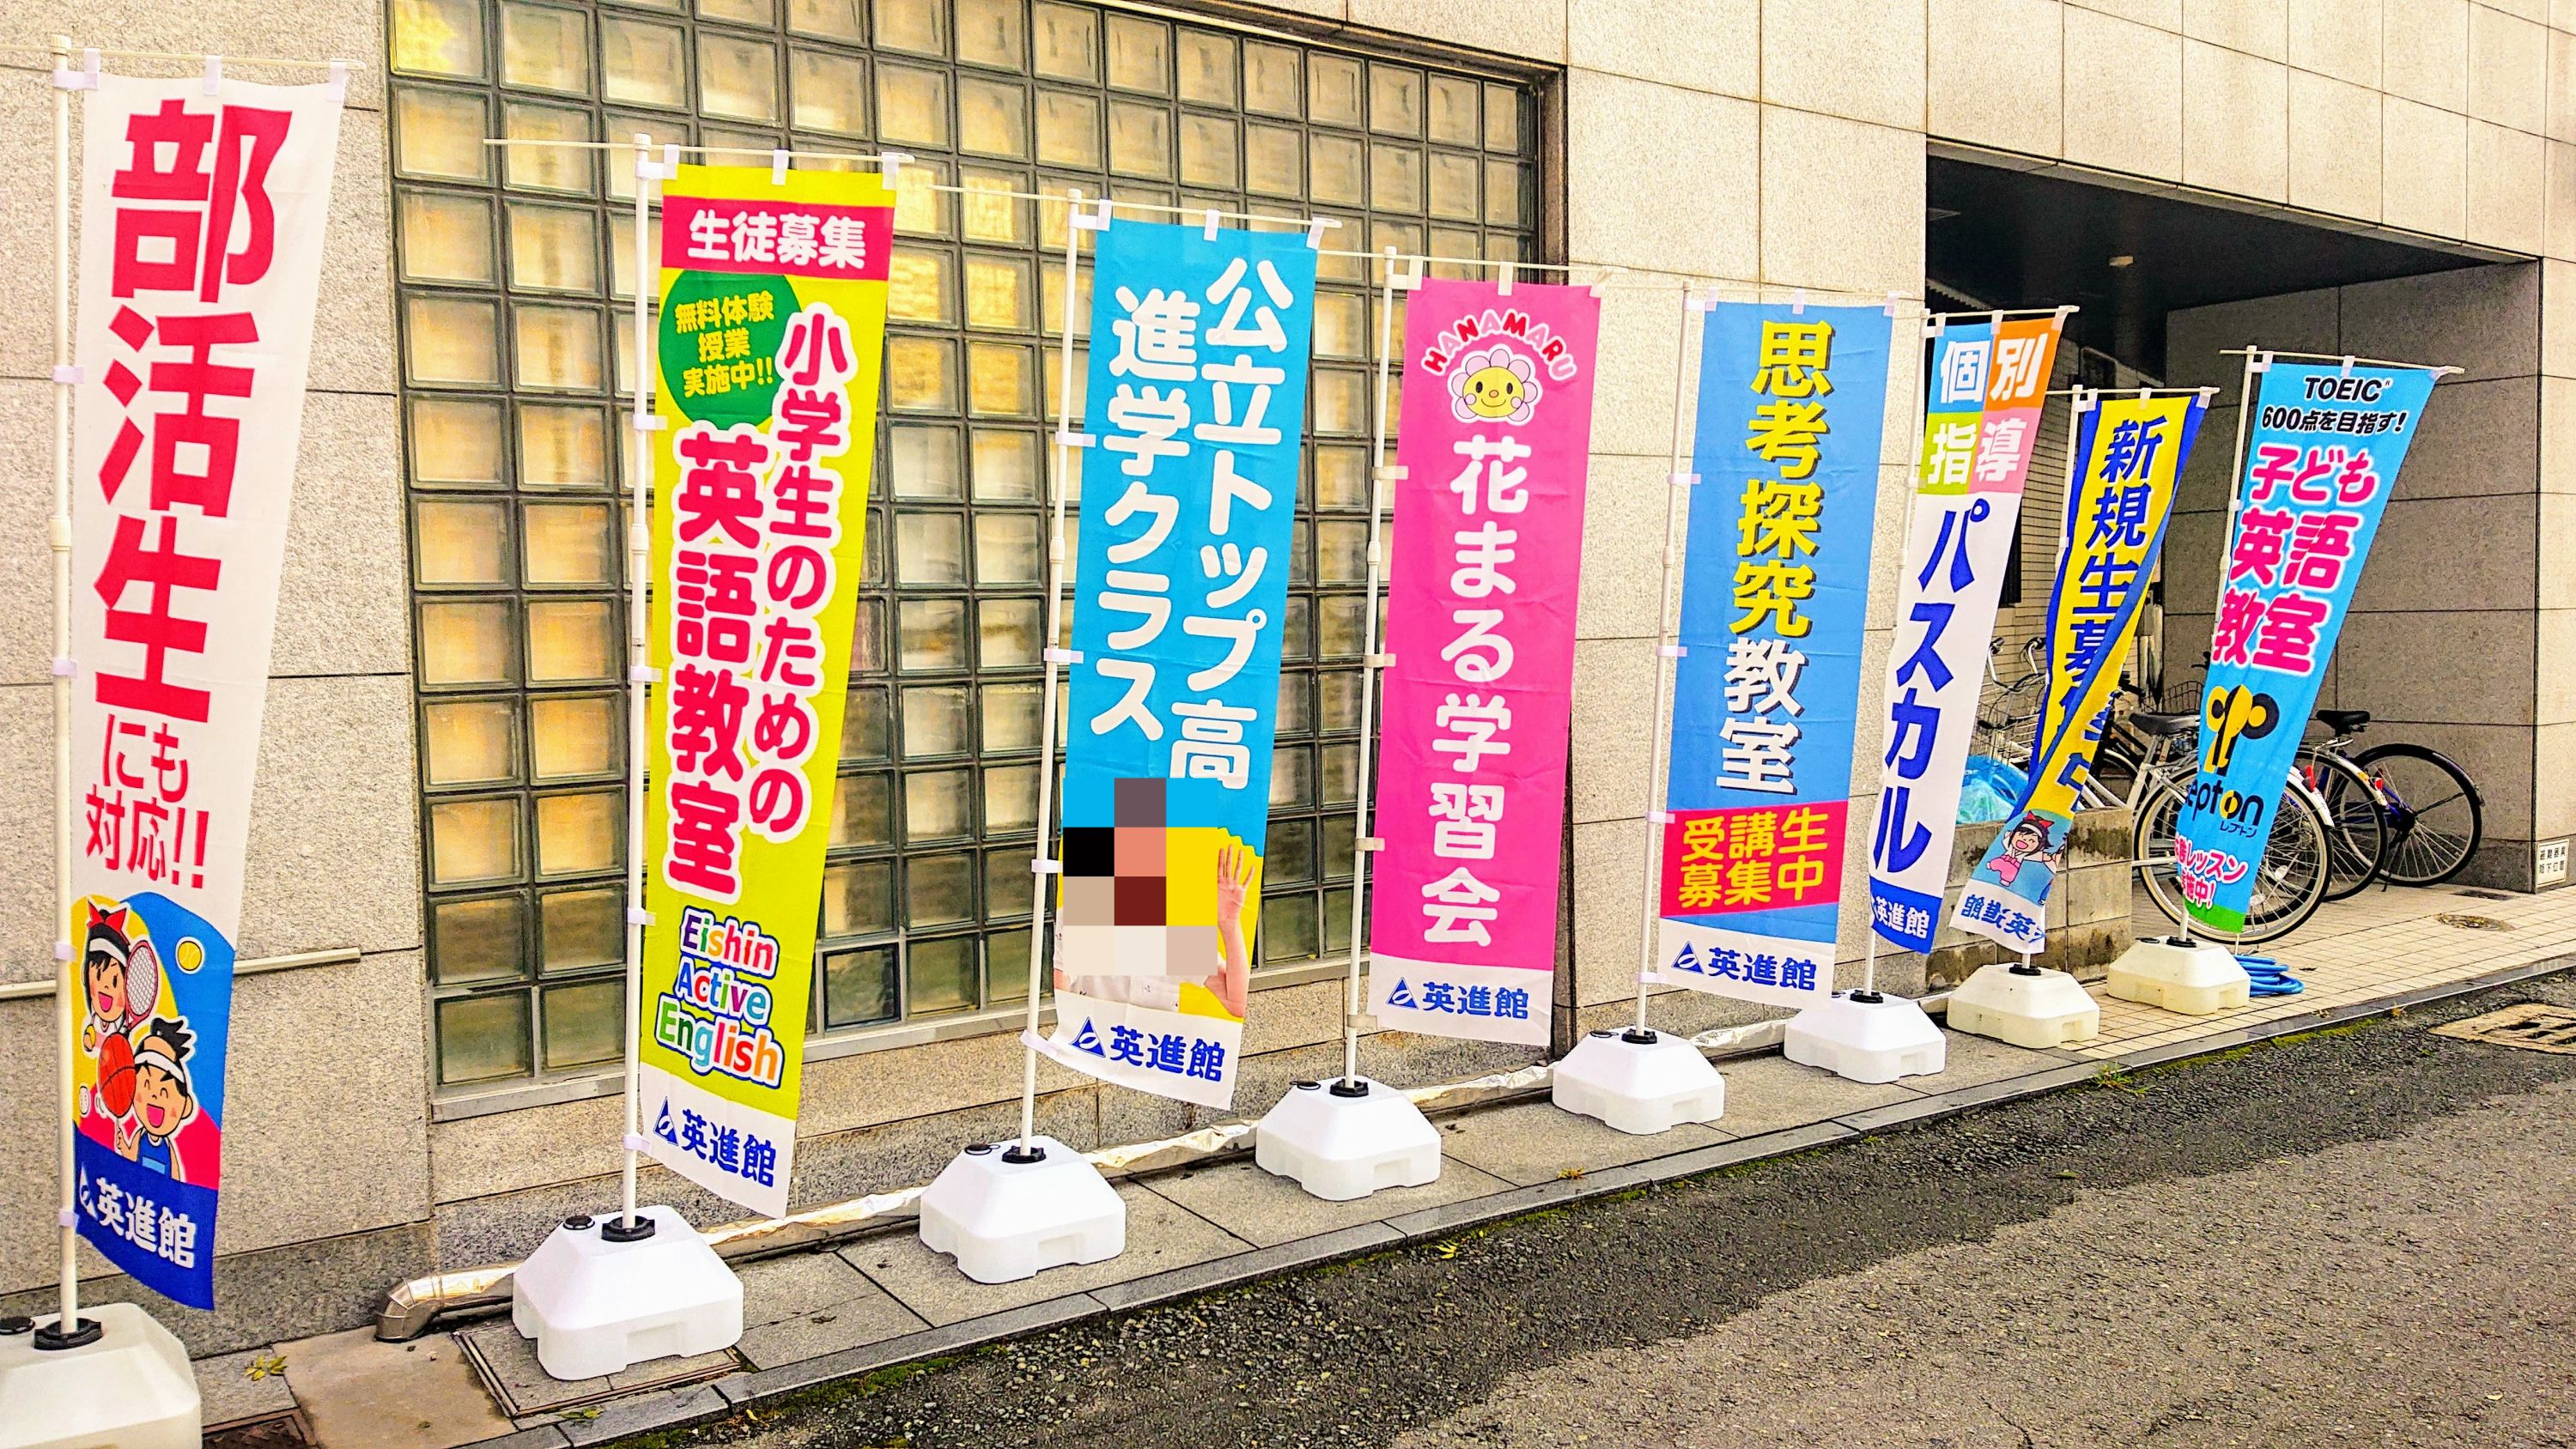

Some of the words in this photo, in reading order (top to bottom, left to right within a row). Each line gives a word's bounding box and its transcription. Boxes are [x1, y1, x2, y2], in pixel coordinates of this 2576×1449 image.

[686, 209, 866, 269] 生徒募集
[675, 290, 775, 334] 無料体験
[698, 327, 750, 362] 授業
[1422, 310, 1576, 380] HANAMARU
[683, 356, 773, 397] 実施中!!
[1940, 333, 2049, 403] 個別
[94, 98, 294, 724] 部活生
[2262, 406, 2408, 434] 600点を目指す!
[1927, 418, 2027, 486] 指導
[2249, 446, 2376, 503] 子ども
[1090, 286, 1201, 742] 進学クラス
[1169, 258, 1294, 791] 公立トップ高
[2229, 507, 2360, 589] 英語
[749, 312, 848, 834] 小学生のための
[1715, 319, 1835, 796] 思考探究教室
[668, 431, 769, 897] 英語教室
[2212, 587, 2328, 673] 教室
[1422, 434, 1532, 947] 花まる学習会
[1872, 498, 1990, 874] パスカル
[101, 713, 189, 803] にも
[84, 790, 210, 889] 対応!!
[1682, 807, 1829, 862] 受講生
[2220, 820, 2257, 839] レプトン
[1679, 855, 1824, 908] 募集中
[683, 913, 774, 972] Eishin
[1874, 895, 1930, 939] 英進館
[677, 961, 767, 1020] Active
[1422, 980, 1529, 1021] 英進館
[1708, 947, 1817, 991] 英進館
[659, 1000, 779, 1081] English
[1110, 1024, 1226, 1083] 英進館
[681, 1107, 778, 1189] 英進館
[95, 1176, 197, 1270] 英進館
